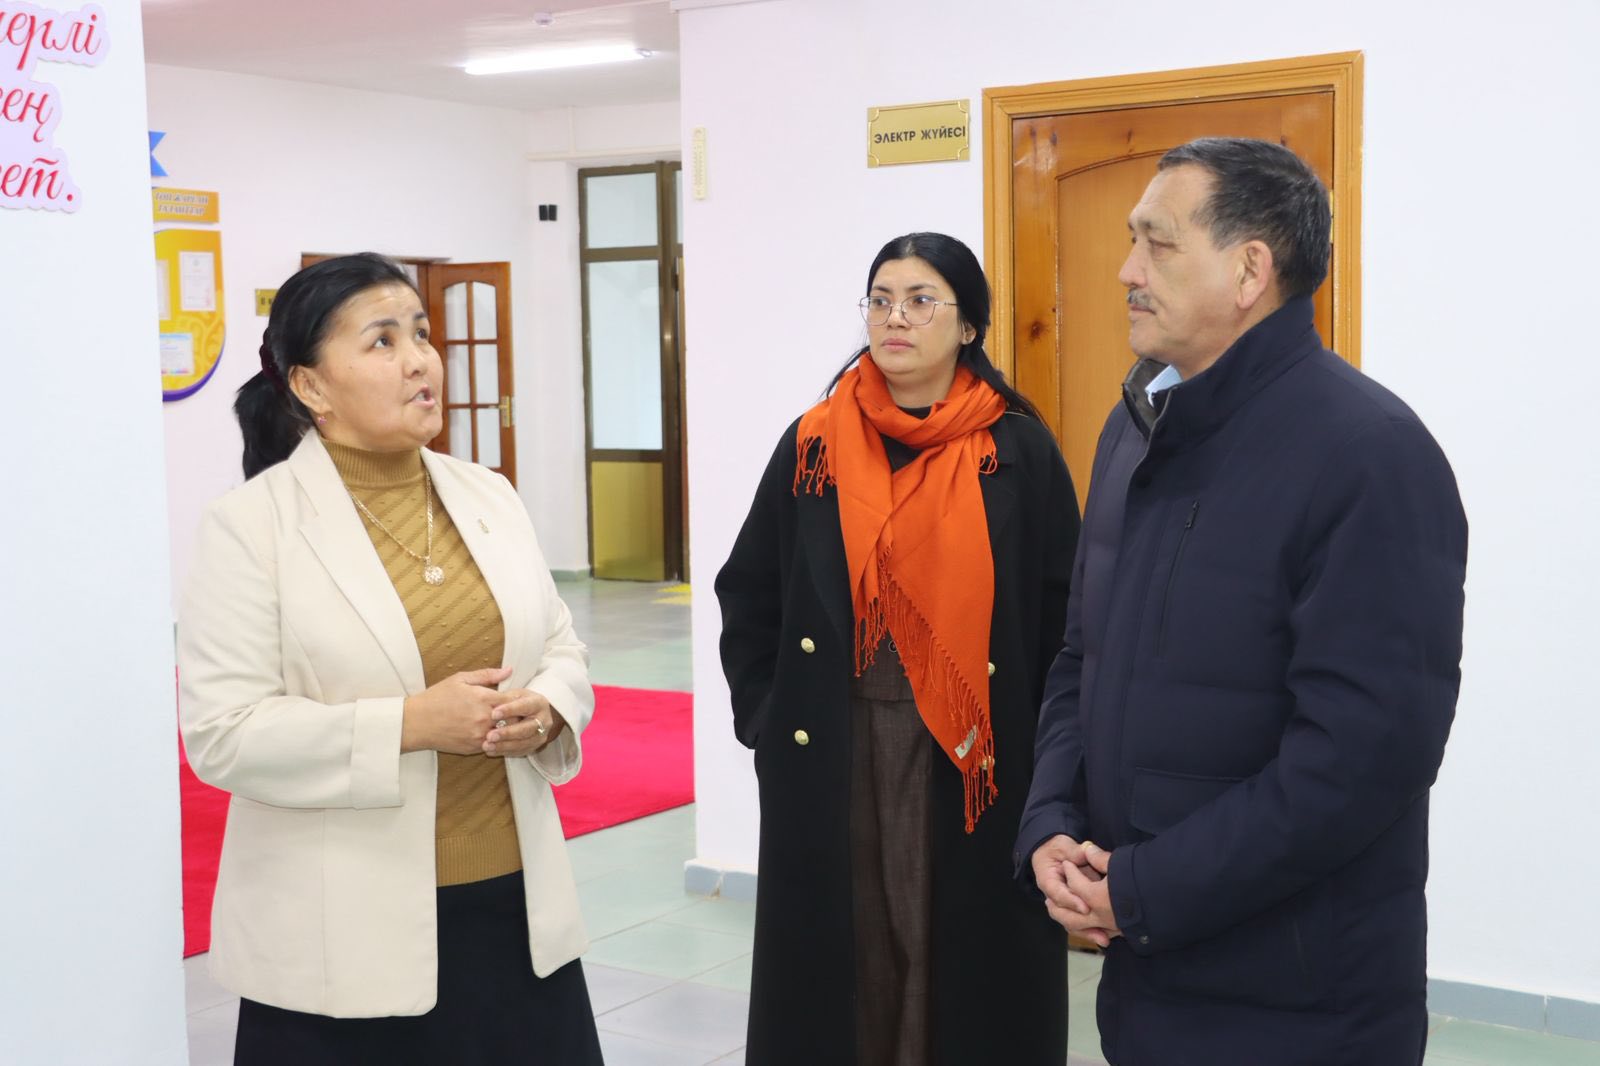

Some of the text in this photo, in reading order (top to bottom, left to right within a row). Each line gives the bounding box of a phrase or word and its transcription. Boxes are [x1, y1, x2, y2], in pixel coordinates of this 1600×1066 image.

[0, 87, 53, 143] ең
[874, 125, 966, 144] ЭЛЕКТР ЖҮЙЕСІ
[0, 157, 73, 202] ет.
